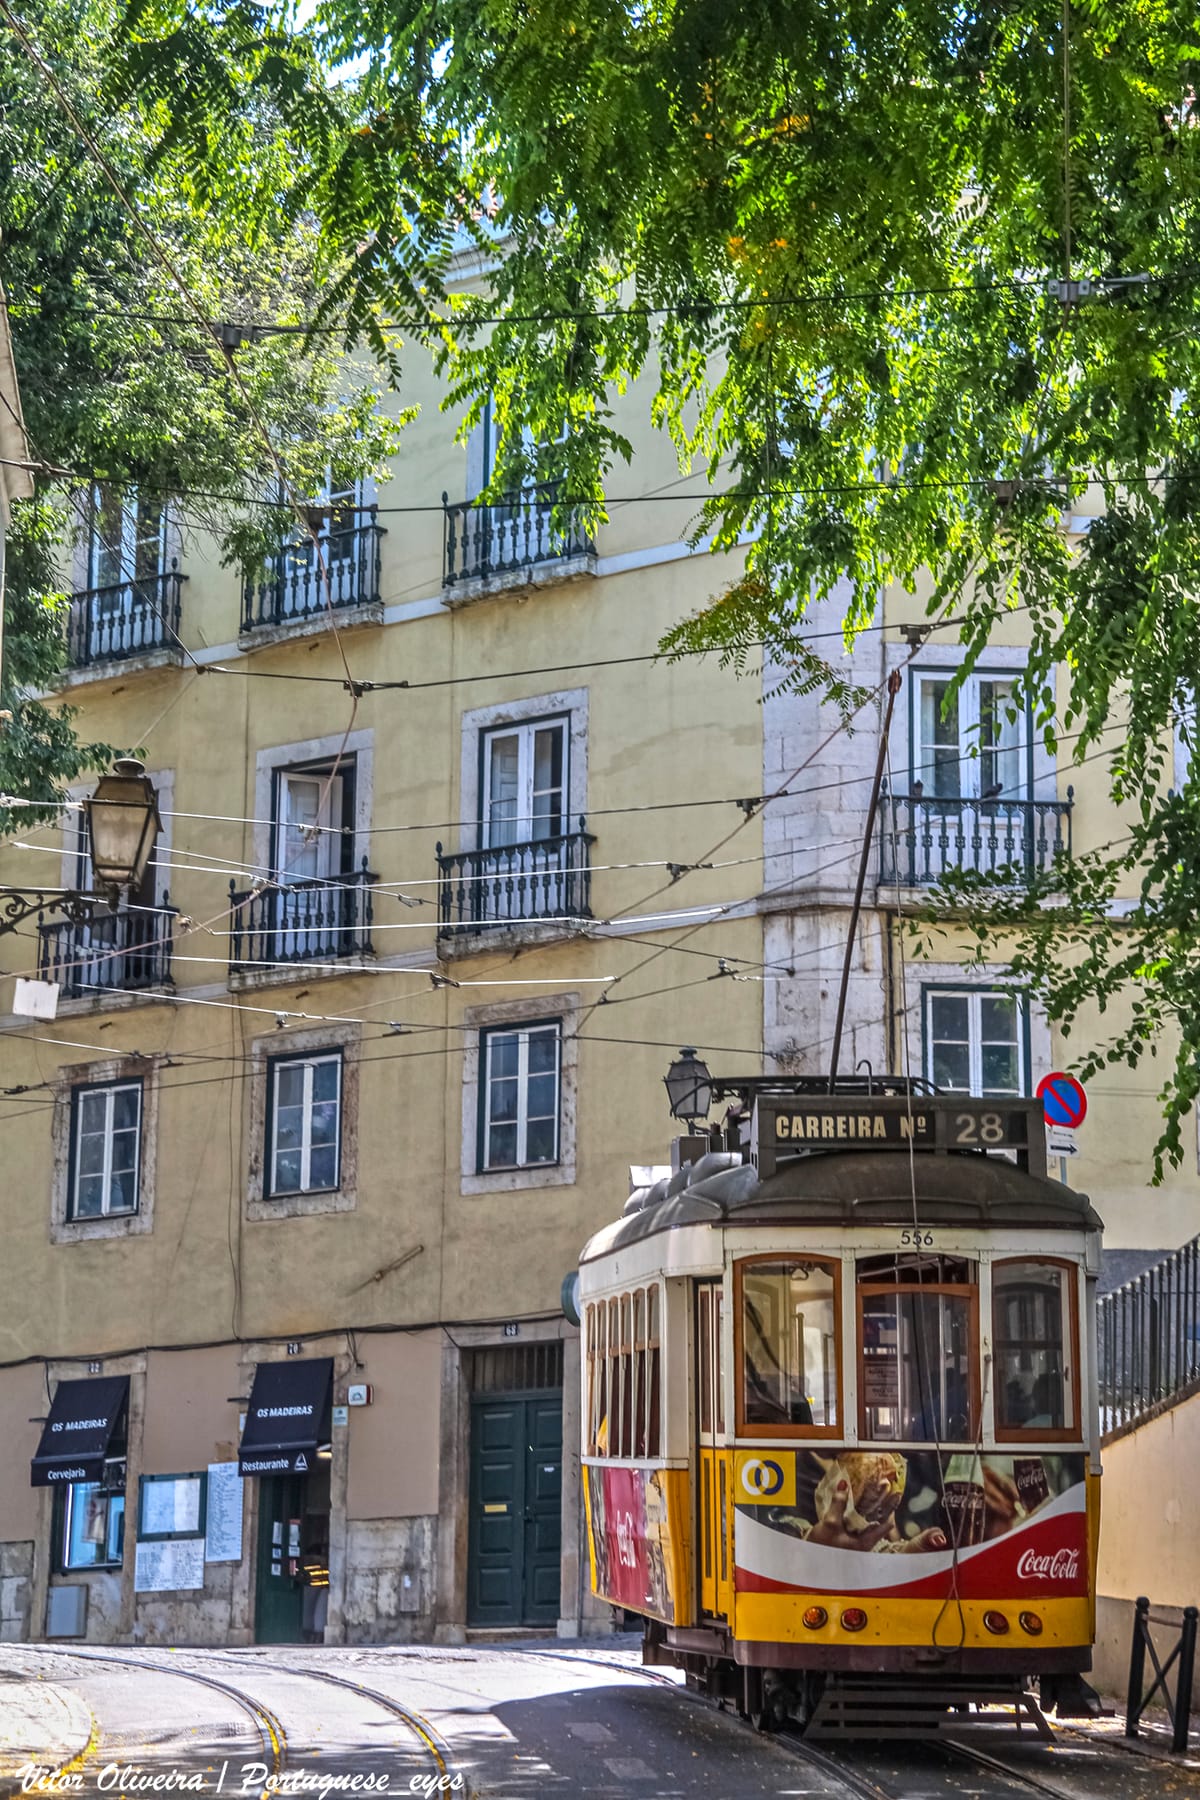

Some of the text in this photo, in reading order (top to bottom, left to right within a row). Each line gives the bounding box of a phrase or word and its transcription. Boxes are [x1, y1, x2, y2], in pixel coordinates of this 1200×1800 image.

[775, 1115, 927, 1139] CARREIRA Nº
[956, 1113, 1004, 1144] 28
[900, 1230, 934, 1246] 556
[257, 1405, 313, 1418] OS MADEIRAS
[52, 1418, 108, 1432] OS MADEIRAS
[241, 1458, 289, 1472] Restaurante
[47, 1468, 86, 1480] Cervejaria
